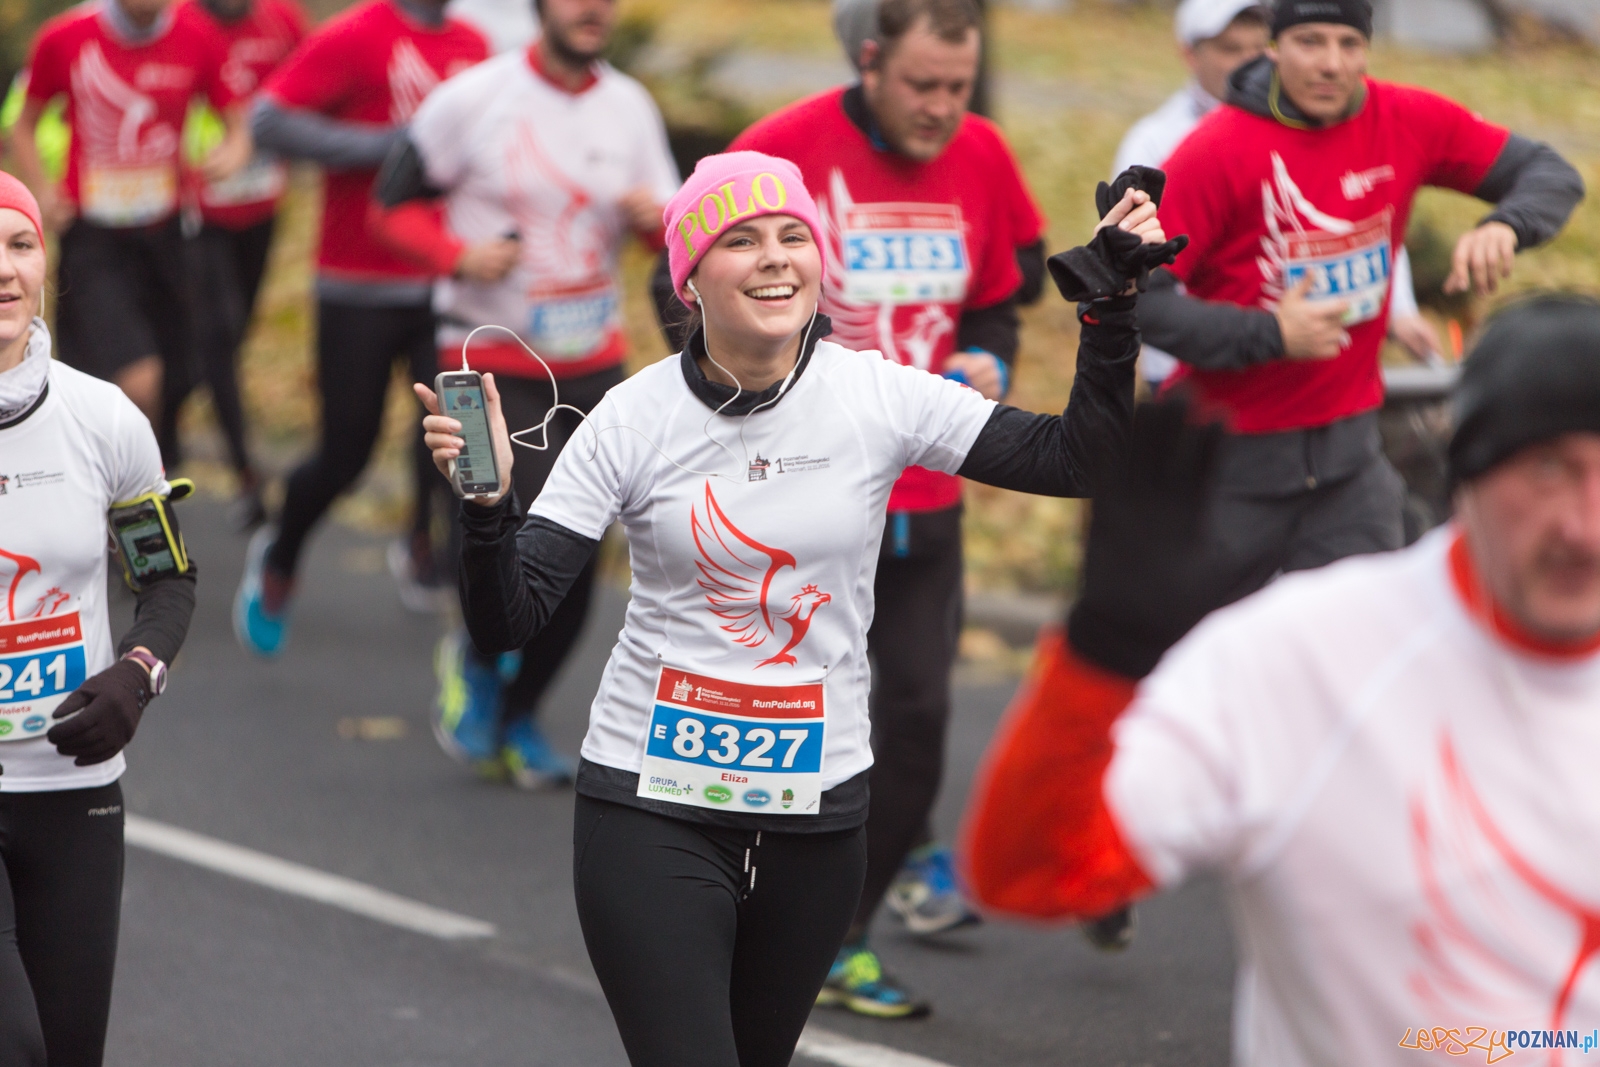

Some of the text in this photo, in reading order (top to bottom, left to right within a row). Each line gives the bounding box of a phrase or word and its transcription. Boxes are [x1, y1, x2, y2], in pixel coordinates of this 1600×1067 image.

[678, 173, 787, 261] POLO
[861, 235, 957, 271] 3183
[775, 457, 785, 474] 1
[16, 625, 76, 645] RunPoland.org
[694, 686, 703, 702] 1
[752, 698, 816, 710] RunPoland.org
[653, 717, 809, 768] E 8327
[649, 776, 678, 788] GRUPA
[721, 772, 749, 784] Eliza
[648, 784, 683, 796] LUXMED
